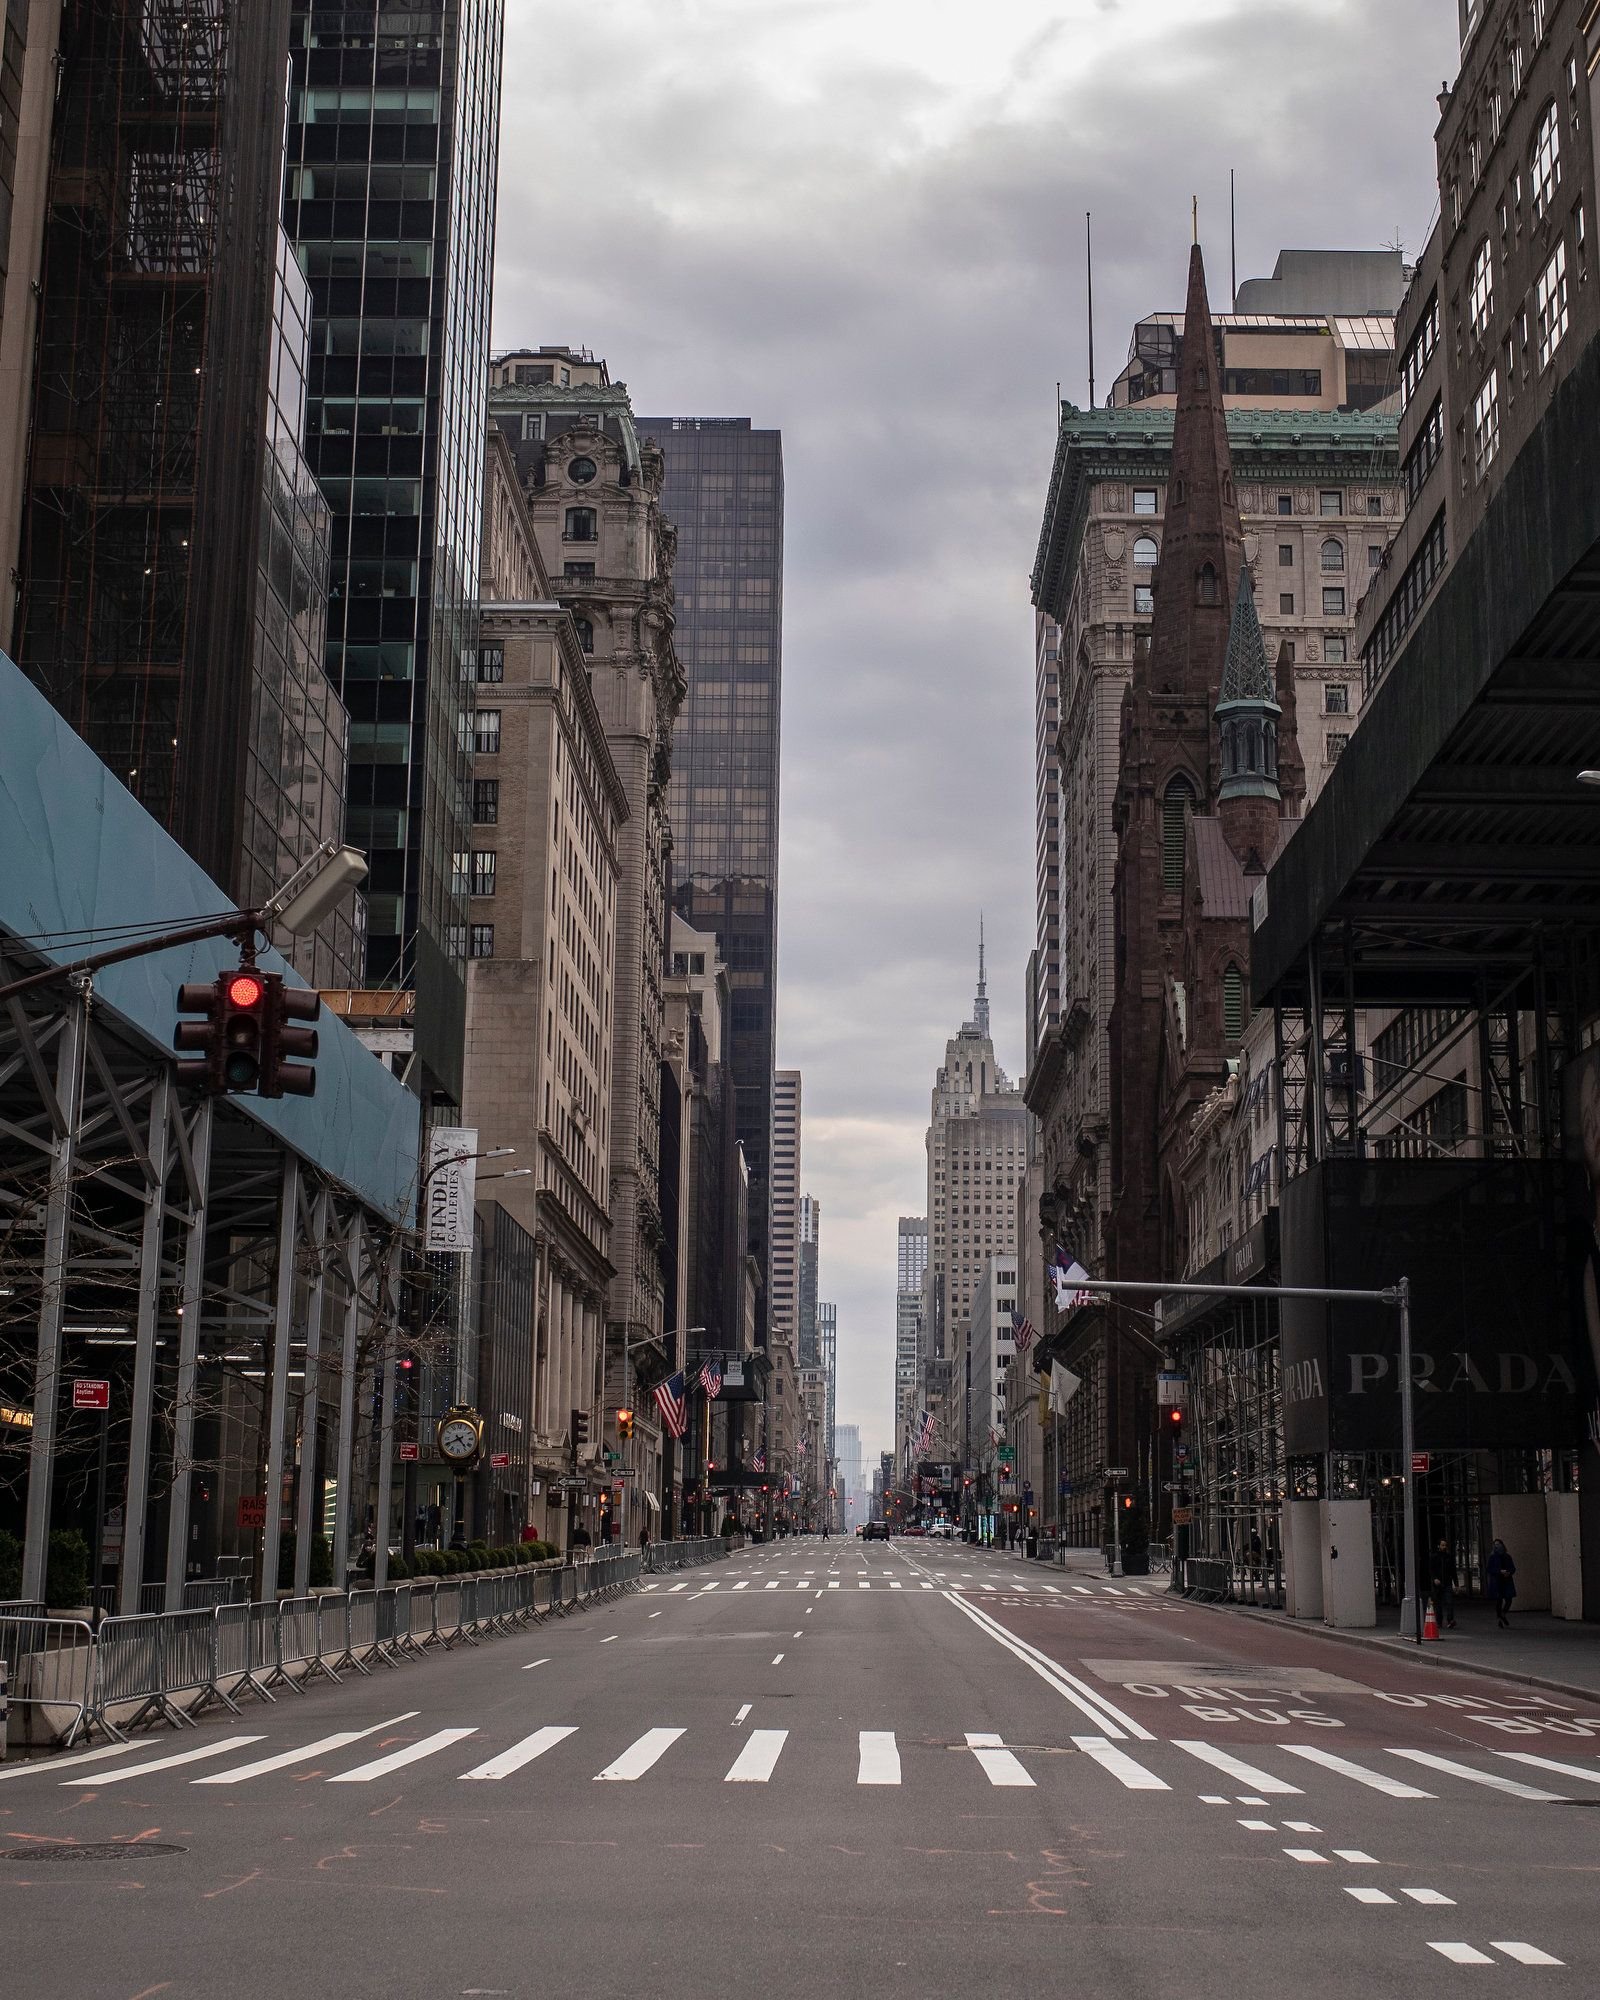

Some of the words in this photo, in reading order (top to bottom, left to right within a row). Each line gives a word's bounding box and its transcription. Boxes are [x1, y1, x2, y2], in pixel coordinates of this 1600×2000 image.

[448, 1169, 459, 1243] GALLERIES
[1235, 1241, 1254, 1276] PRADA
[1285, 1358, 1324, 1405] PRADA
[1346, 1352, 1577, 1394] PRADA
[242, 1499, 266, 1510] RAIS
[1122, 1683, 1318, 1704] ONLY
[1373, 1693, 1577, 1711] ONLY
[1178, 1704, 1346, 1727] BUS
